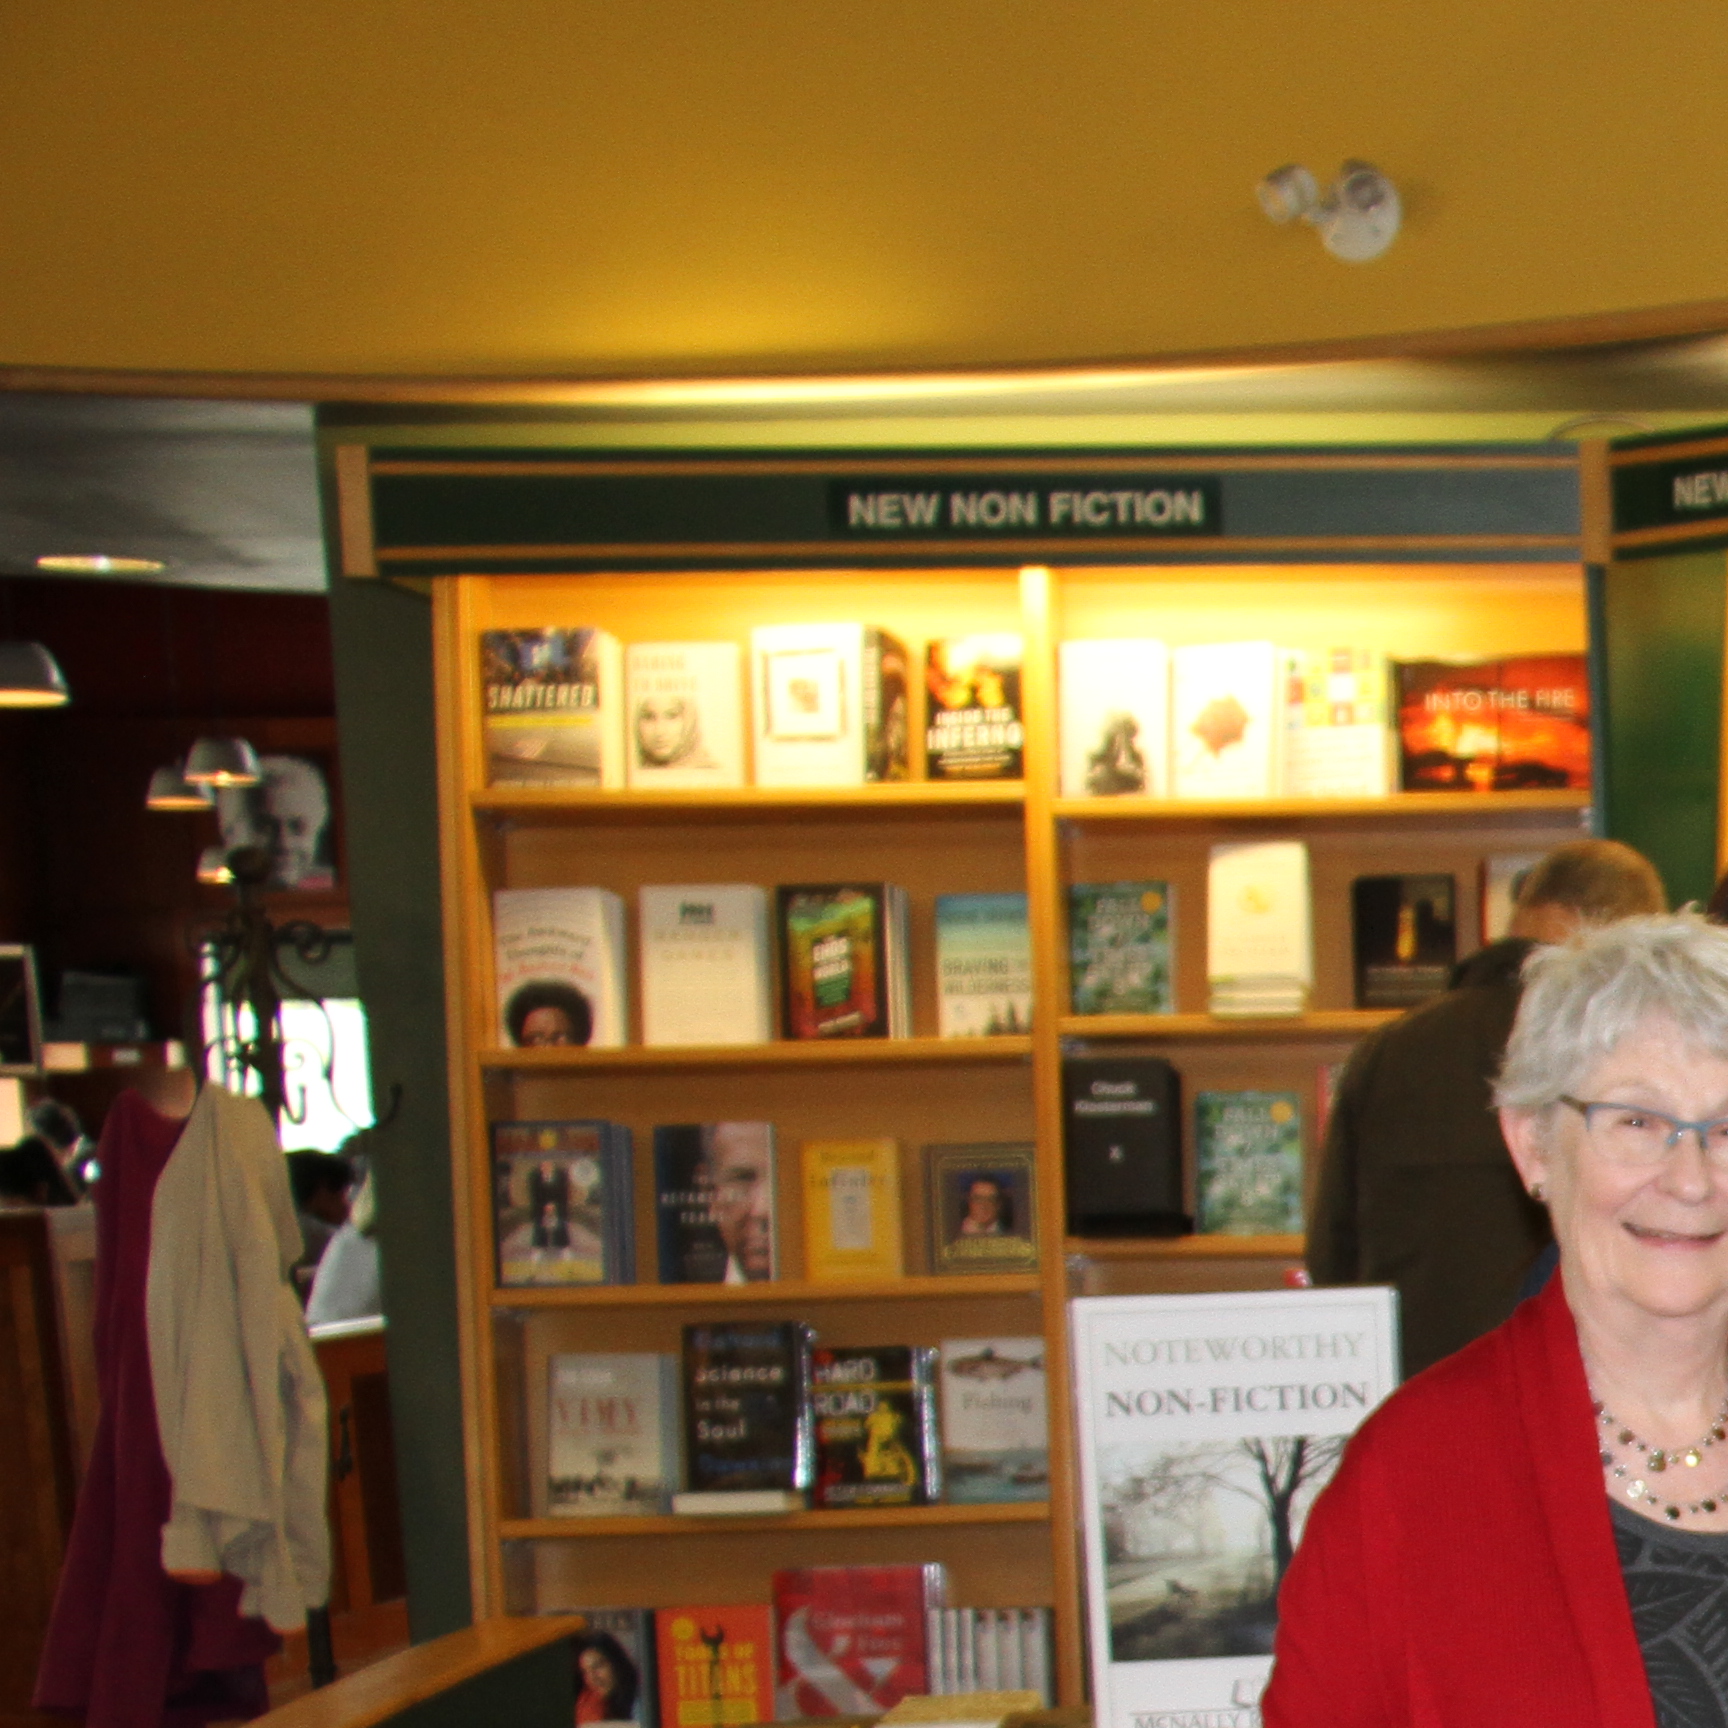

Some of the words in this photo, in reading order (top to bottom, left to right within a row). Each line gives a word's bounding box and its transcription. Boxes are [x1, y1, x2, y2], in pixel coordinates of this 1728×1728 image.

[848, 494, 938, 527] NEW
[951, 493, 1037, 525] NON
[1050, 491, 1202, 523] FICTION
[488, 684, 595, 710] SHATTERED
[1425, 690, 1482, 713] INTO
[1487, 688, 1529, 711] THE
[1536, 686, 1575, 708] FIRE
[927, 724, 1023, 749] INFERNO
[1103, 1331, 1365, 1369] NOTEWORTHY
[695, 1366, 785, 1384] Science
[814, 1358, 876, 1383] HARD
[714, 1397, 741, 1412] the
[814, 1389, 876, 1415] ROAD
[1105, 1382, 1368, 1417] NON-FICTION
[697, 1419, 747, 1440] Soul
